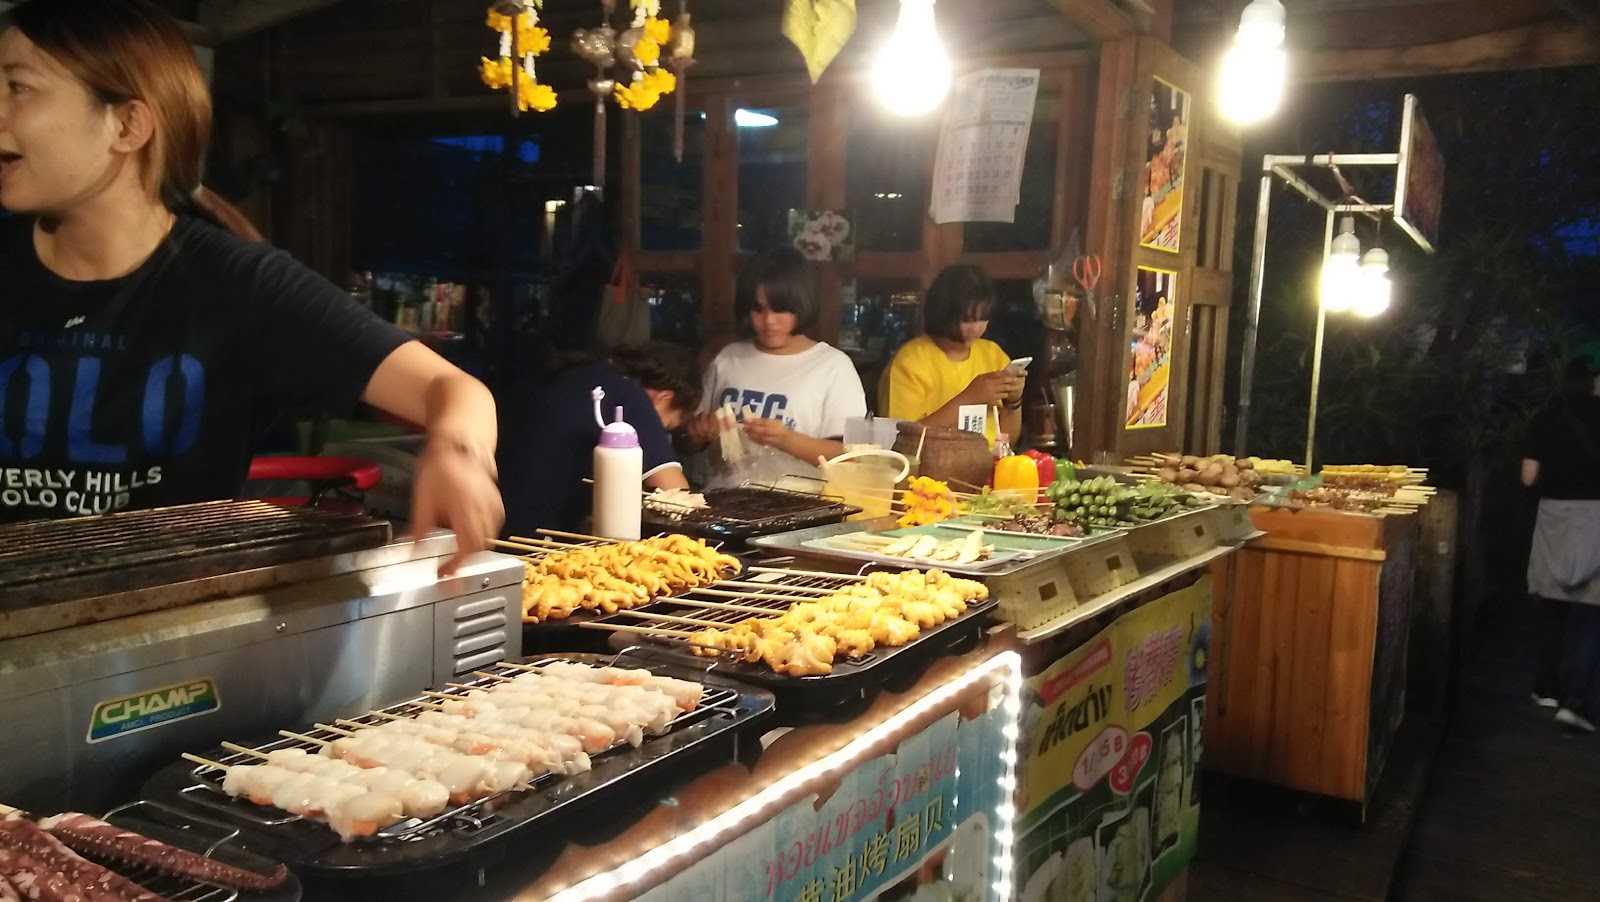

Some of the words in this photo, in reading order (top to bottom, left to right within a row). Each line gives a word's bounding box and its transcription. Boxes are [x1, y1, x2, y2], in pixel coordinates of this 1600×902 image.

[86, 465, 162, 493] HILLS
[65, 490, 130, 515] CLUB
[101, 682, 208, 724] CHAMP
